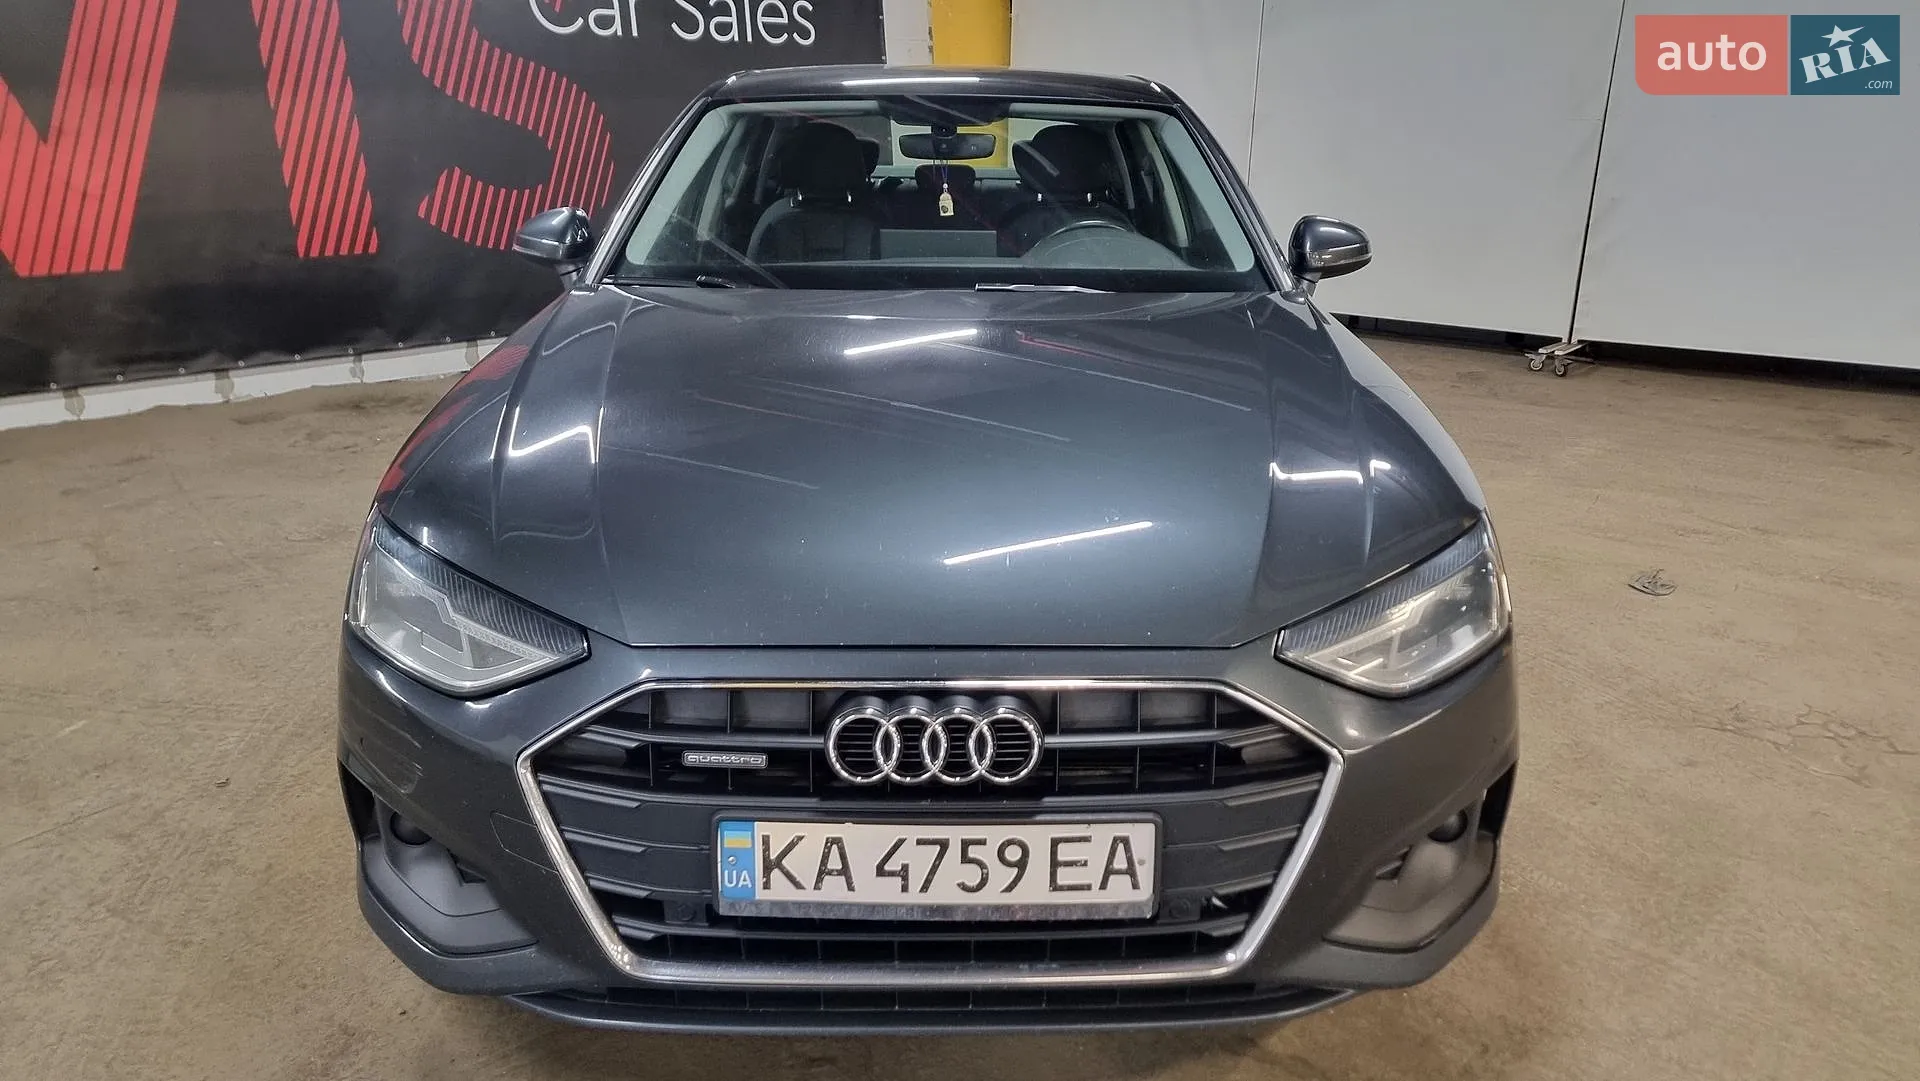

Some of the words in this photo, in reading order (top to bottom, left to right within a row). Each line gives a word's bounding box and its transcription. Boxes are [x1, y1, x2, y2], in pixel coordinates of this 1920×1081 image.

[670, 0, 816, 46] Sales
[687, 755, 762, 764] quattro
[724, 870, 752, 888] UA
[761, 834, 856, 892] KA
[875, 837, 1030, 893] 4759
[1049, 834, 1141, 892] EA
